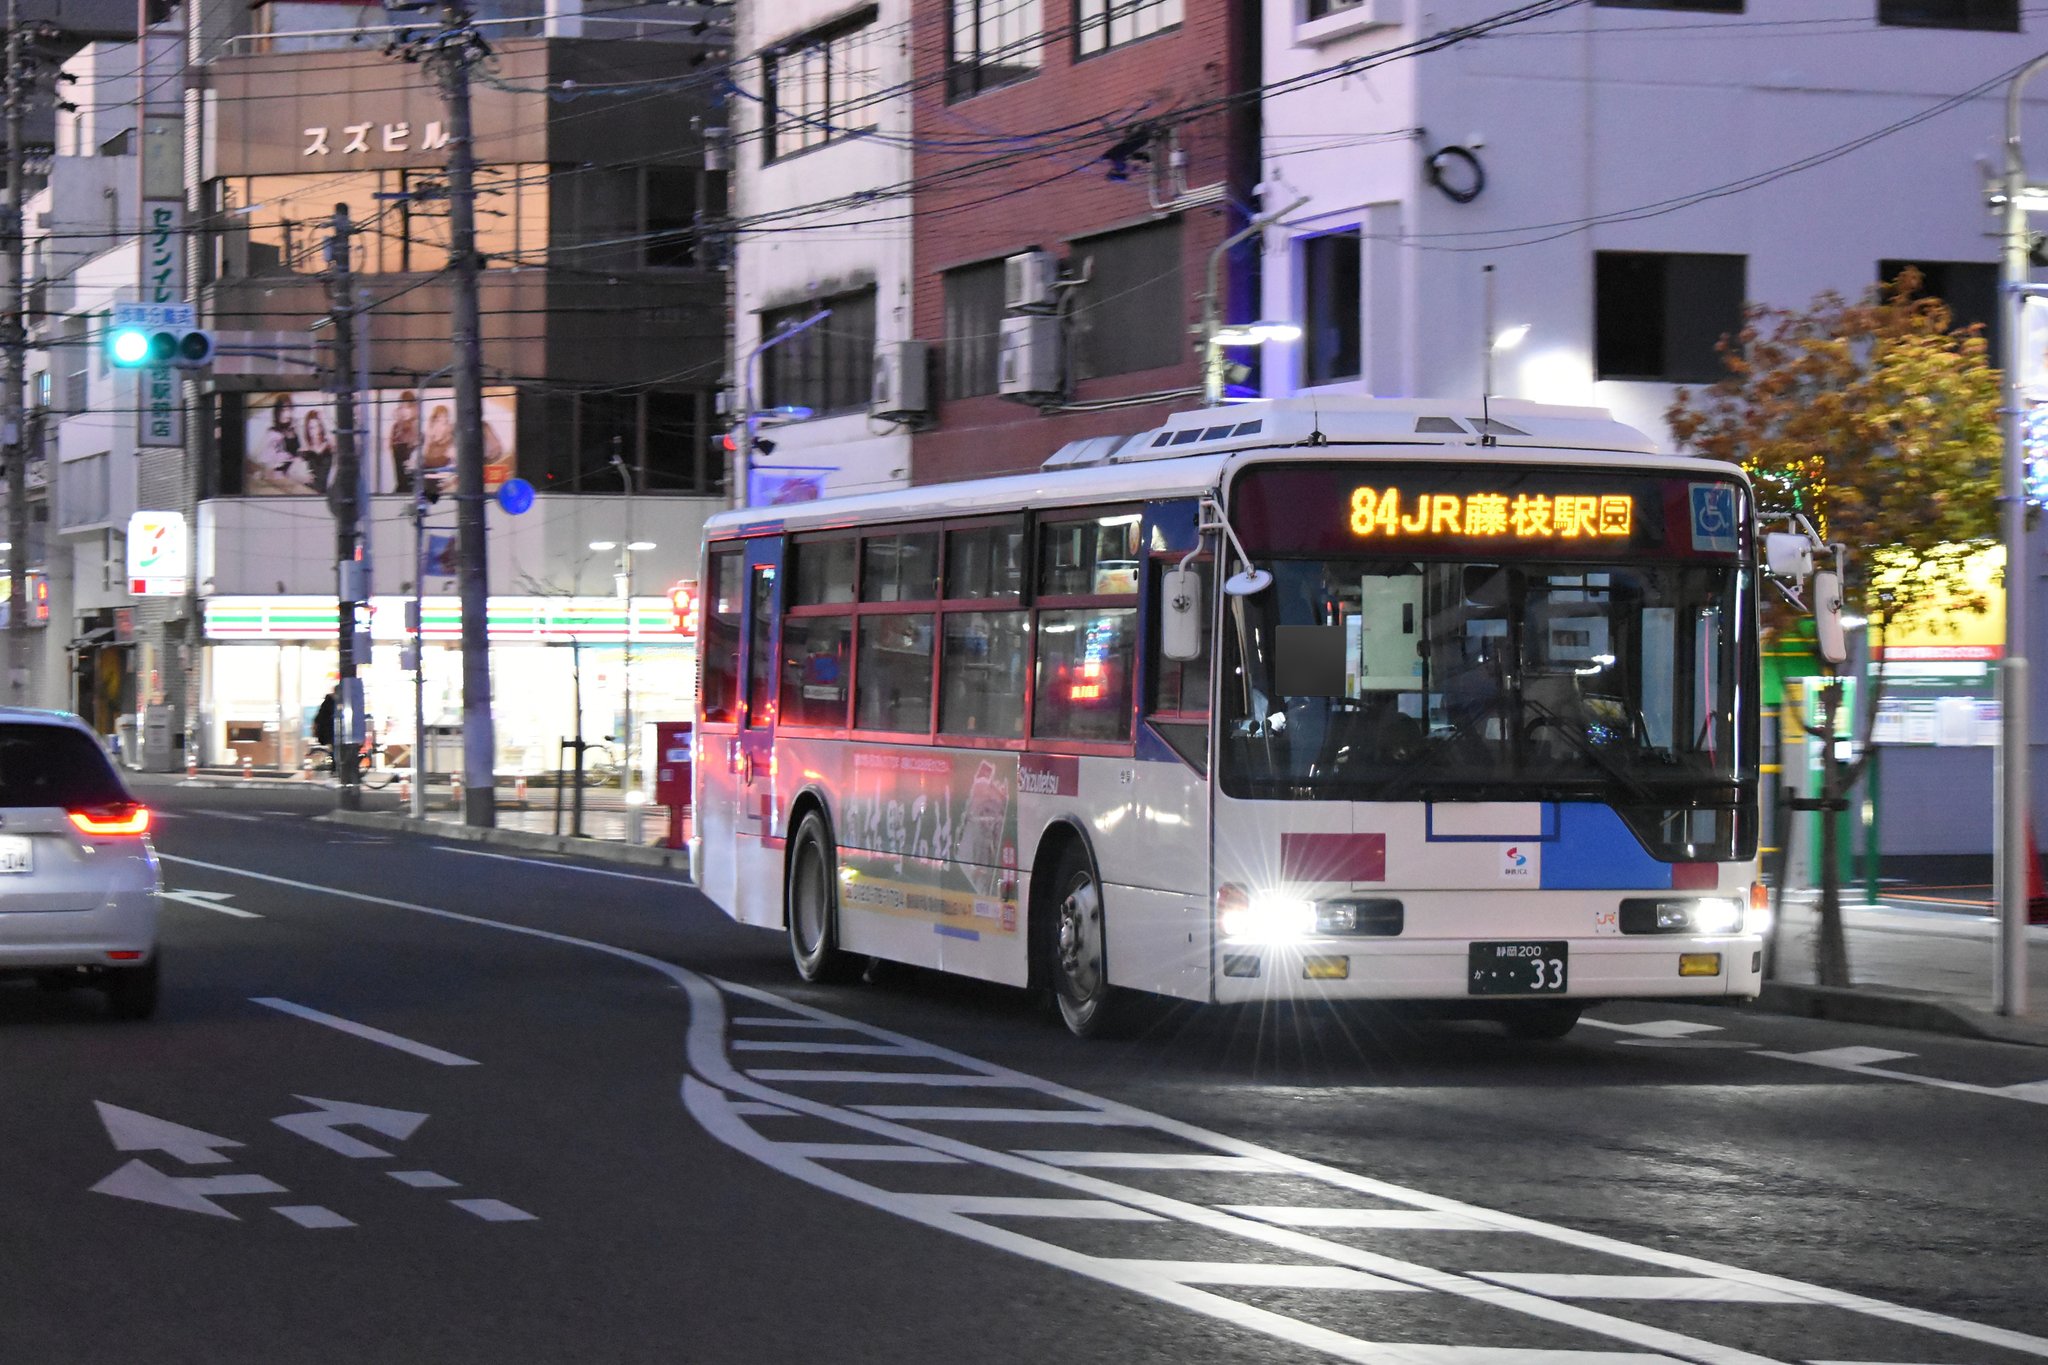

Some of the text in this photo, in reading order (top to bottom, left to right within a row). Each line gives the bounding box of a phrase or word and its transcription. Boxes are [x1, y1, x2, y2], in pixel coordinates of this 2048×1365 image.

[303, 121, 450, 156] スズビル
[1019, 766, 1059, 794] Shizutetsu
